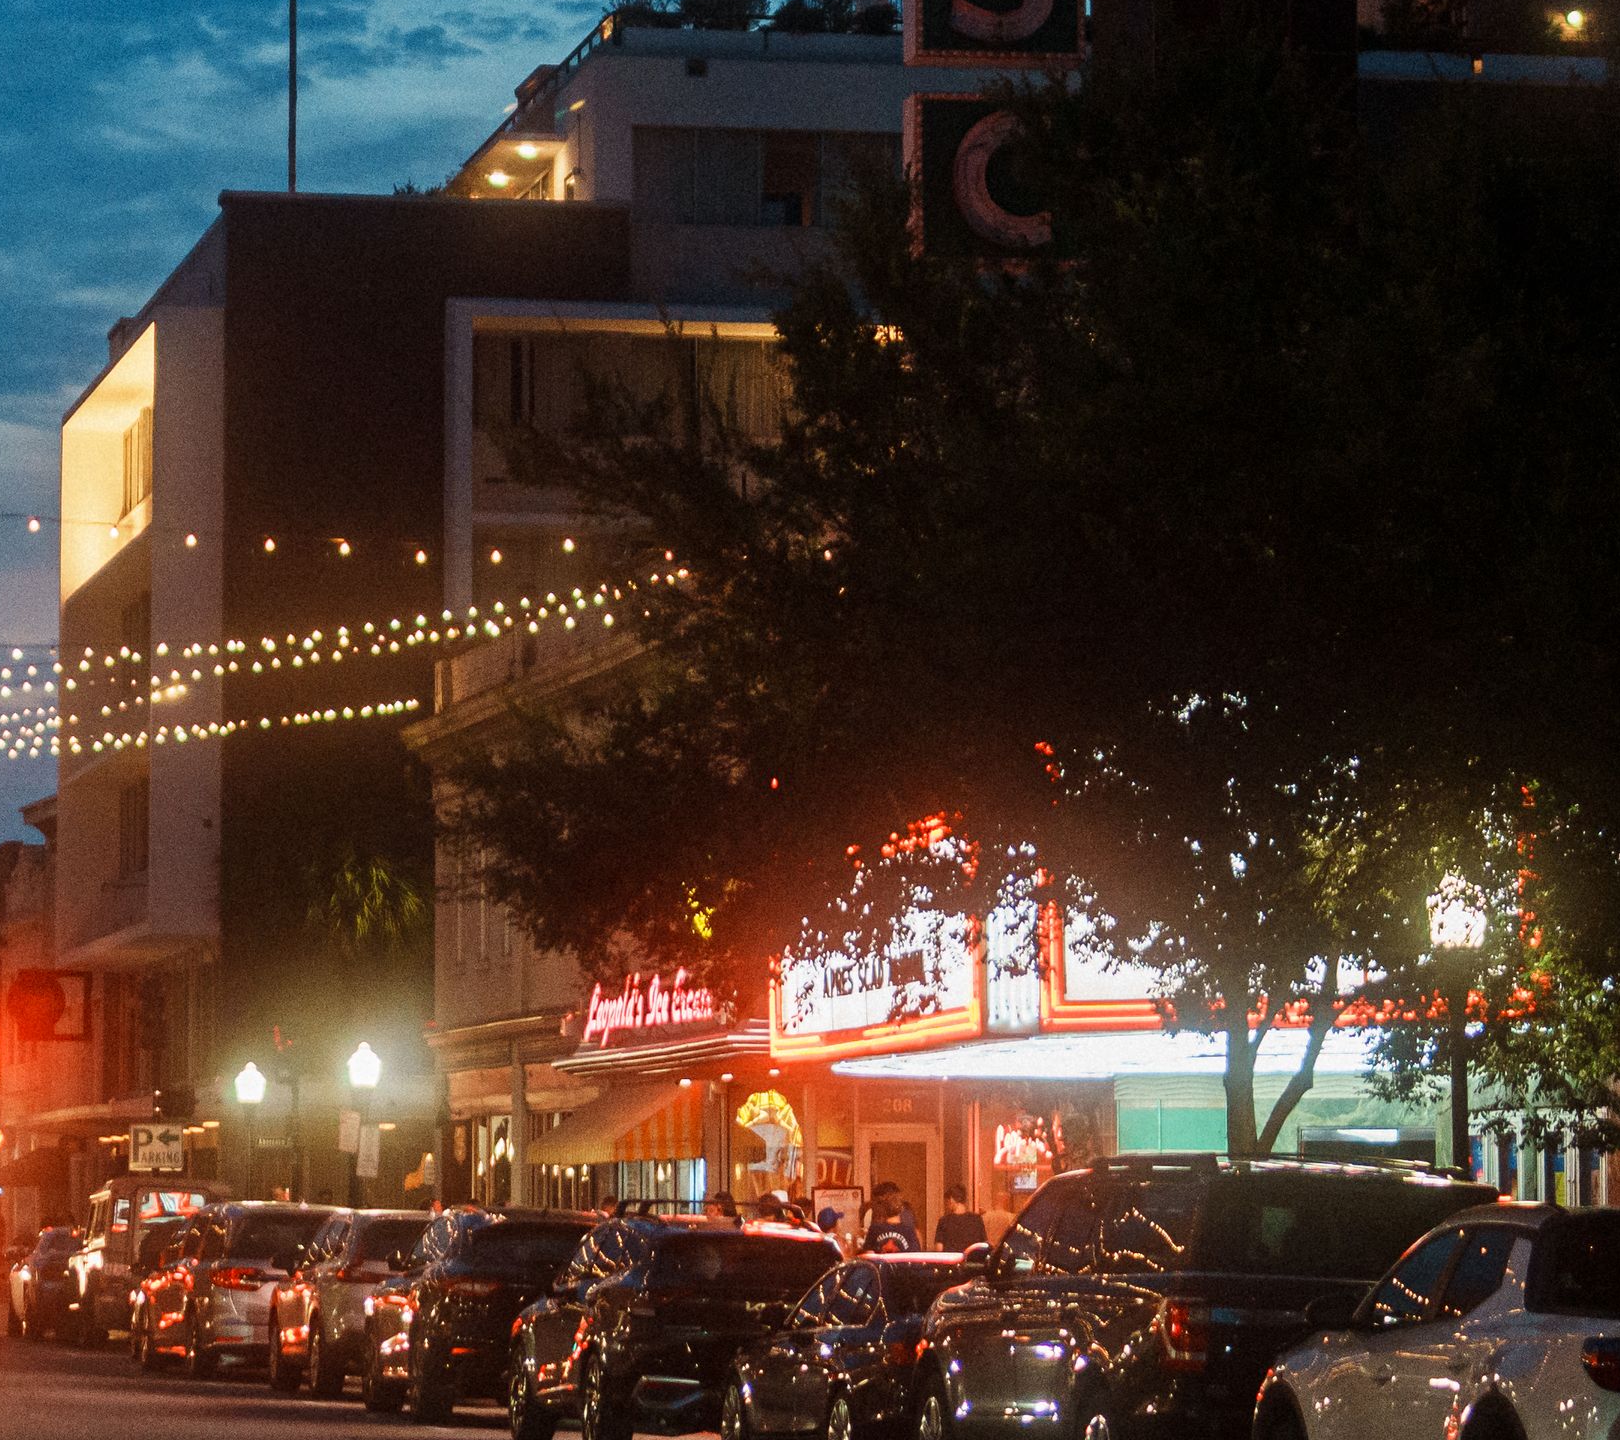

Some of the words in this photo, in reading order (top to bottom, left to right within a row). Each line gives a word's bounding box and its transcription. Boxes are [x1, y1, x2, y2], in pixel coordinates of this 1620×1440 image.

[583, 971, 644, 1048] Leopold's
[644, 973, 671, 1027] Ice
[882, 1097, 914, 1114] 208
